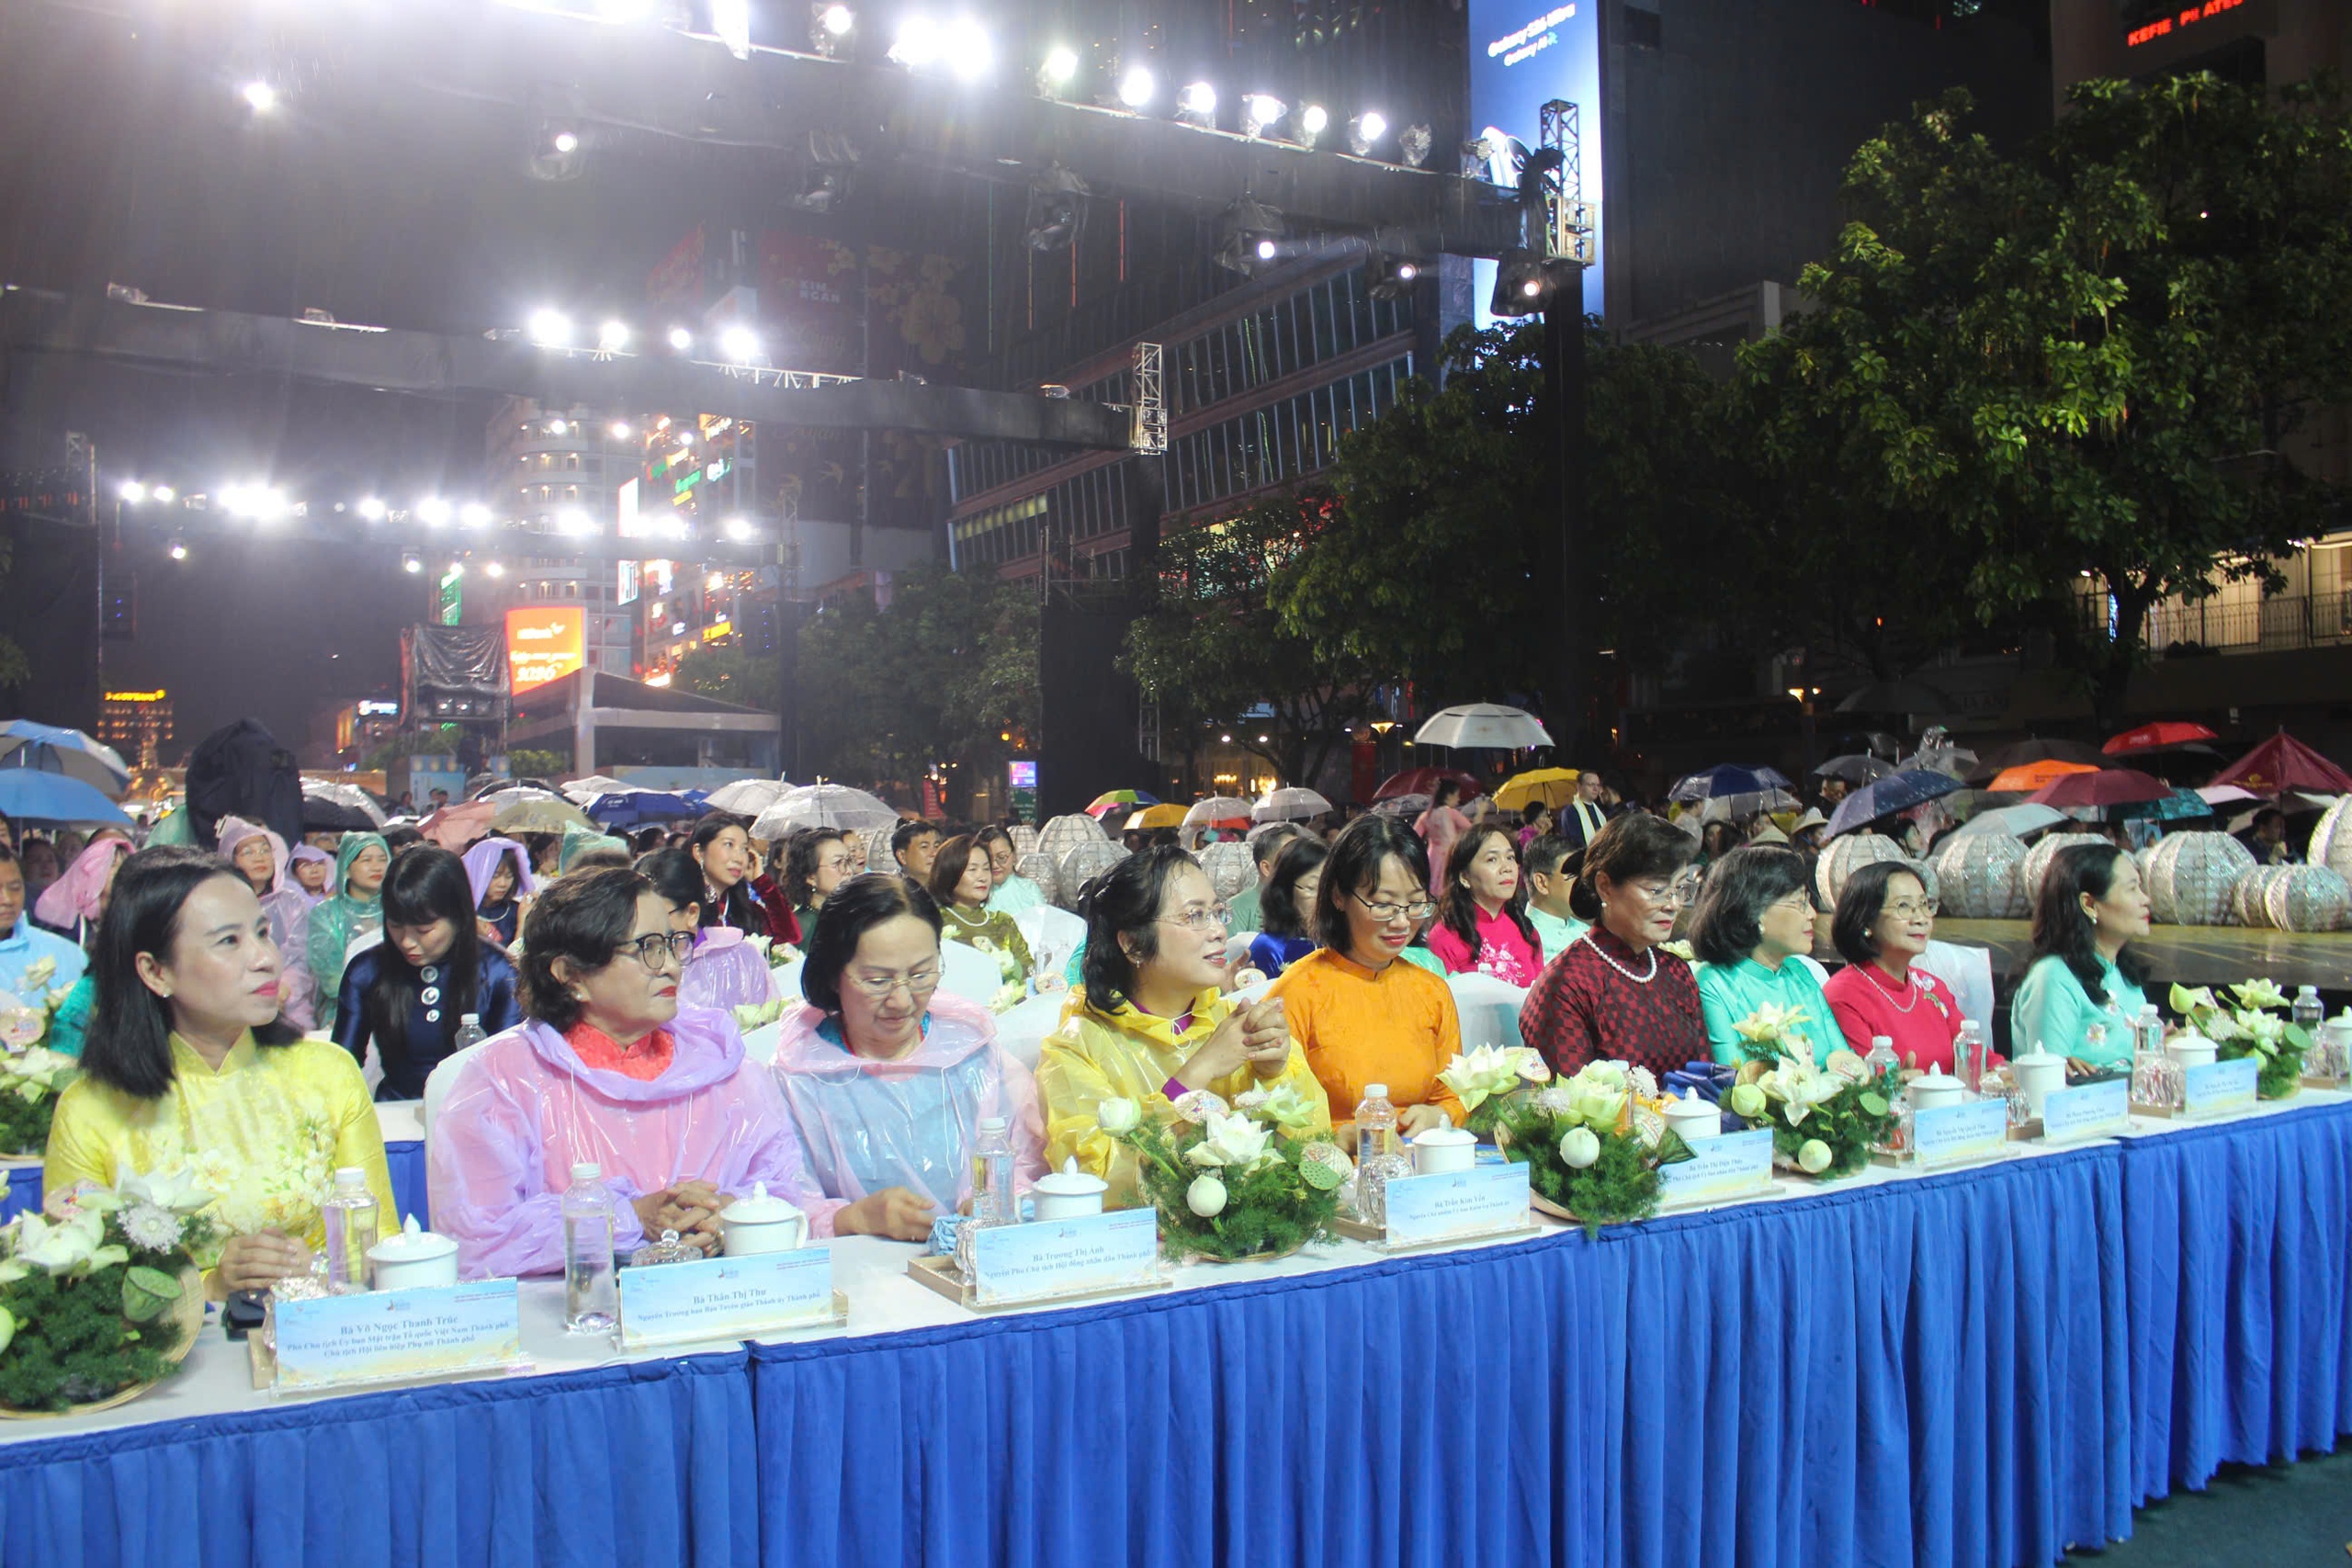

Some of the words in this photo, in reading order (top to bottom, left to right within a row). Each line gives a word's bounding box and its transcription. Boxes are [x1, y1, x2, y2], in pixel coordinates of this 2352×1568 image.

[693, 1293, 704, 1305] Bà
[732, 1289, 747, 1300] Thị
[340, 1325, 354, 1335] Bà
[357, 1322, 371, 1333] Võ
[374, 1321, 398, 1333] Ngọc
[401, 1318, 433, 1329] Thanh
[451, 1325, 468, 1334] Nam
[470, 1323, 493, 1333] Thành
[436, 1336, 460, 1347] Thành
